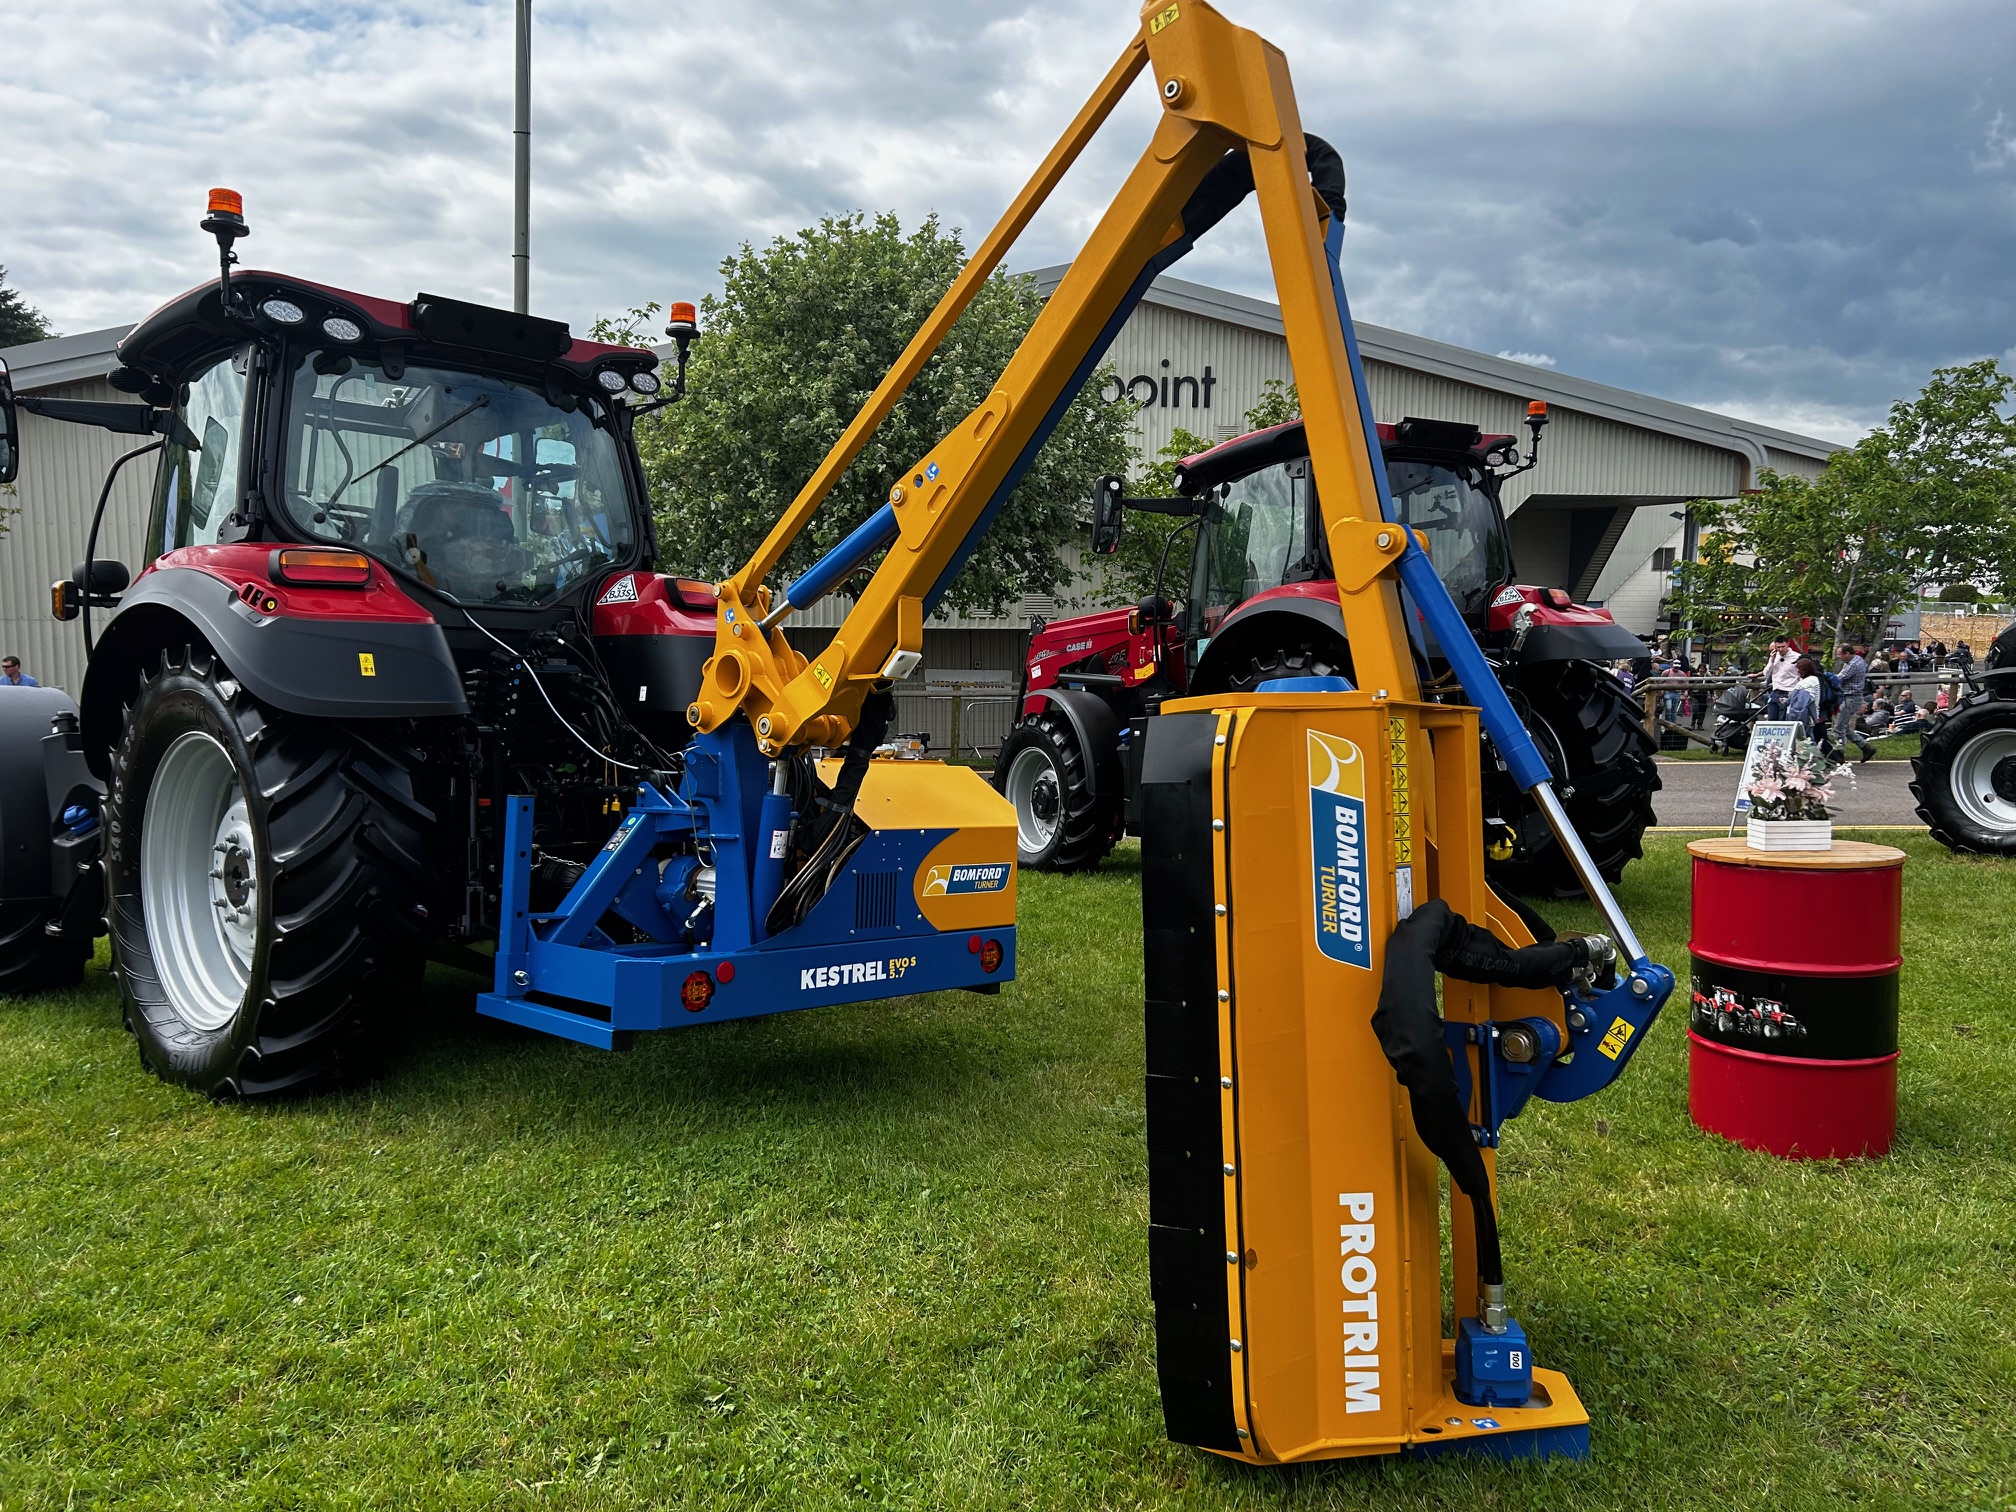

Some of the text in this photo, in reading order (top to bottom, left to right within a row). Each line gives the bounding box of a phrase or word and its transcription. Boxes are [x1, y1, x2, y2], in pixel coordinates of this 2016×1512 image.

[1066, 641, 1087, 652] CASE
[1758, 727, 1791, 737] TRACTOR
[952, 867, 1002, 882] BOMFORD
[1334, 804, 1363, 945] BOMFORD
[974, 880, 999, 889] TURNER
[1320, 865, 1338, 934] TURNER
[800, 960, 887, 990] KESTREL
[889, 957, 910, 969] EVO
[889, 967, 906, 979] 5.7
[1338, 1192, 1381, 1414] PROTRIM
[1512, 1352, 1520, 1368] 100
